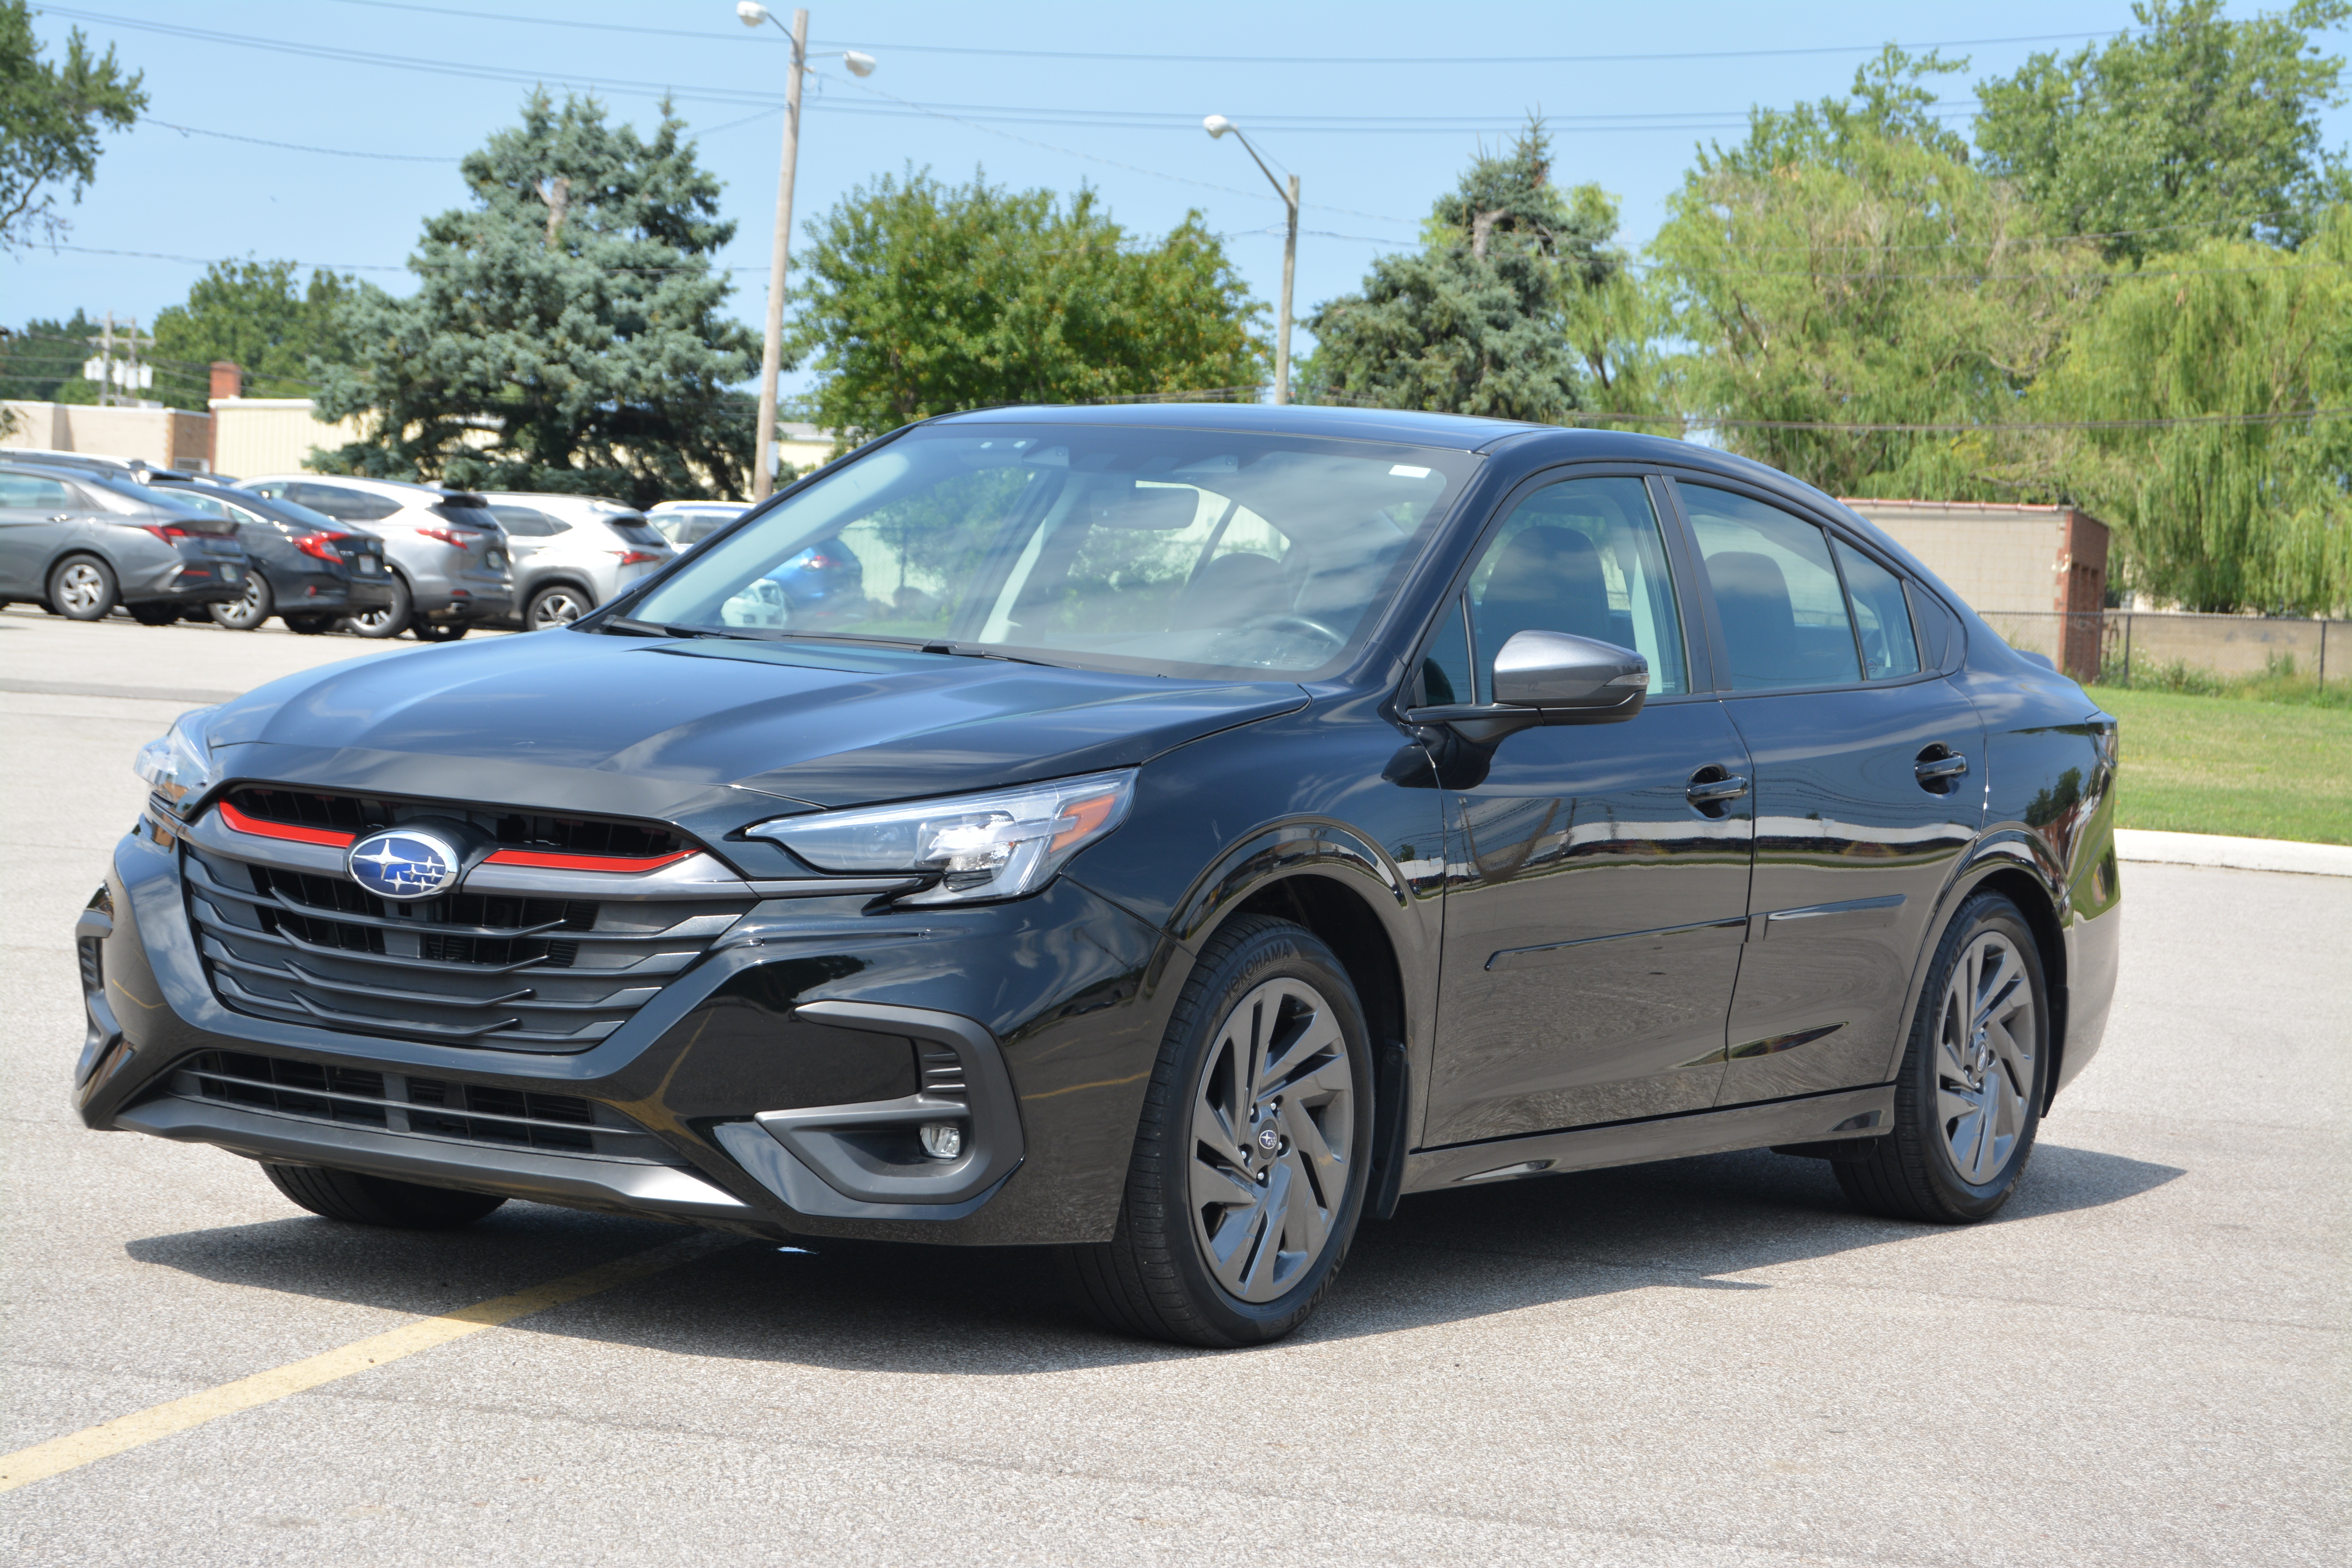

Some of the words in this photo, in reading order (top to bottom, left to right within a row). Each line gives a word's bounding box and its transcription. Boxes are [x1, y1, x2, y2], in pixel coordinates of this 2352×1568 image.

[1222, 941, 1290, 1000] YOKOHAMA
[1310, 1241, 1346, 1310] AVID
[1287, 1305, 1307, 1328] GT
